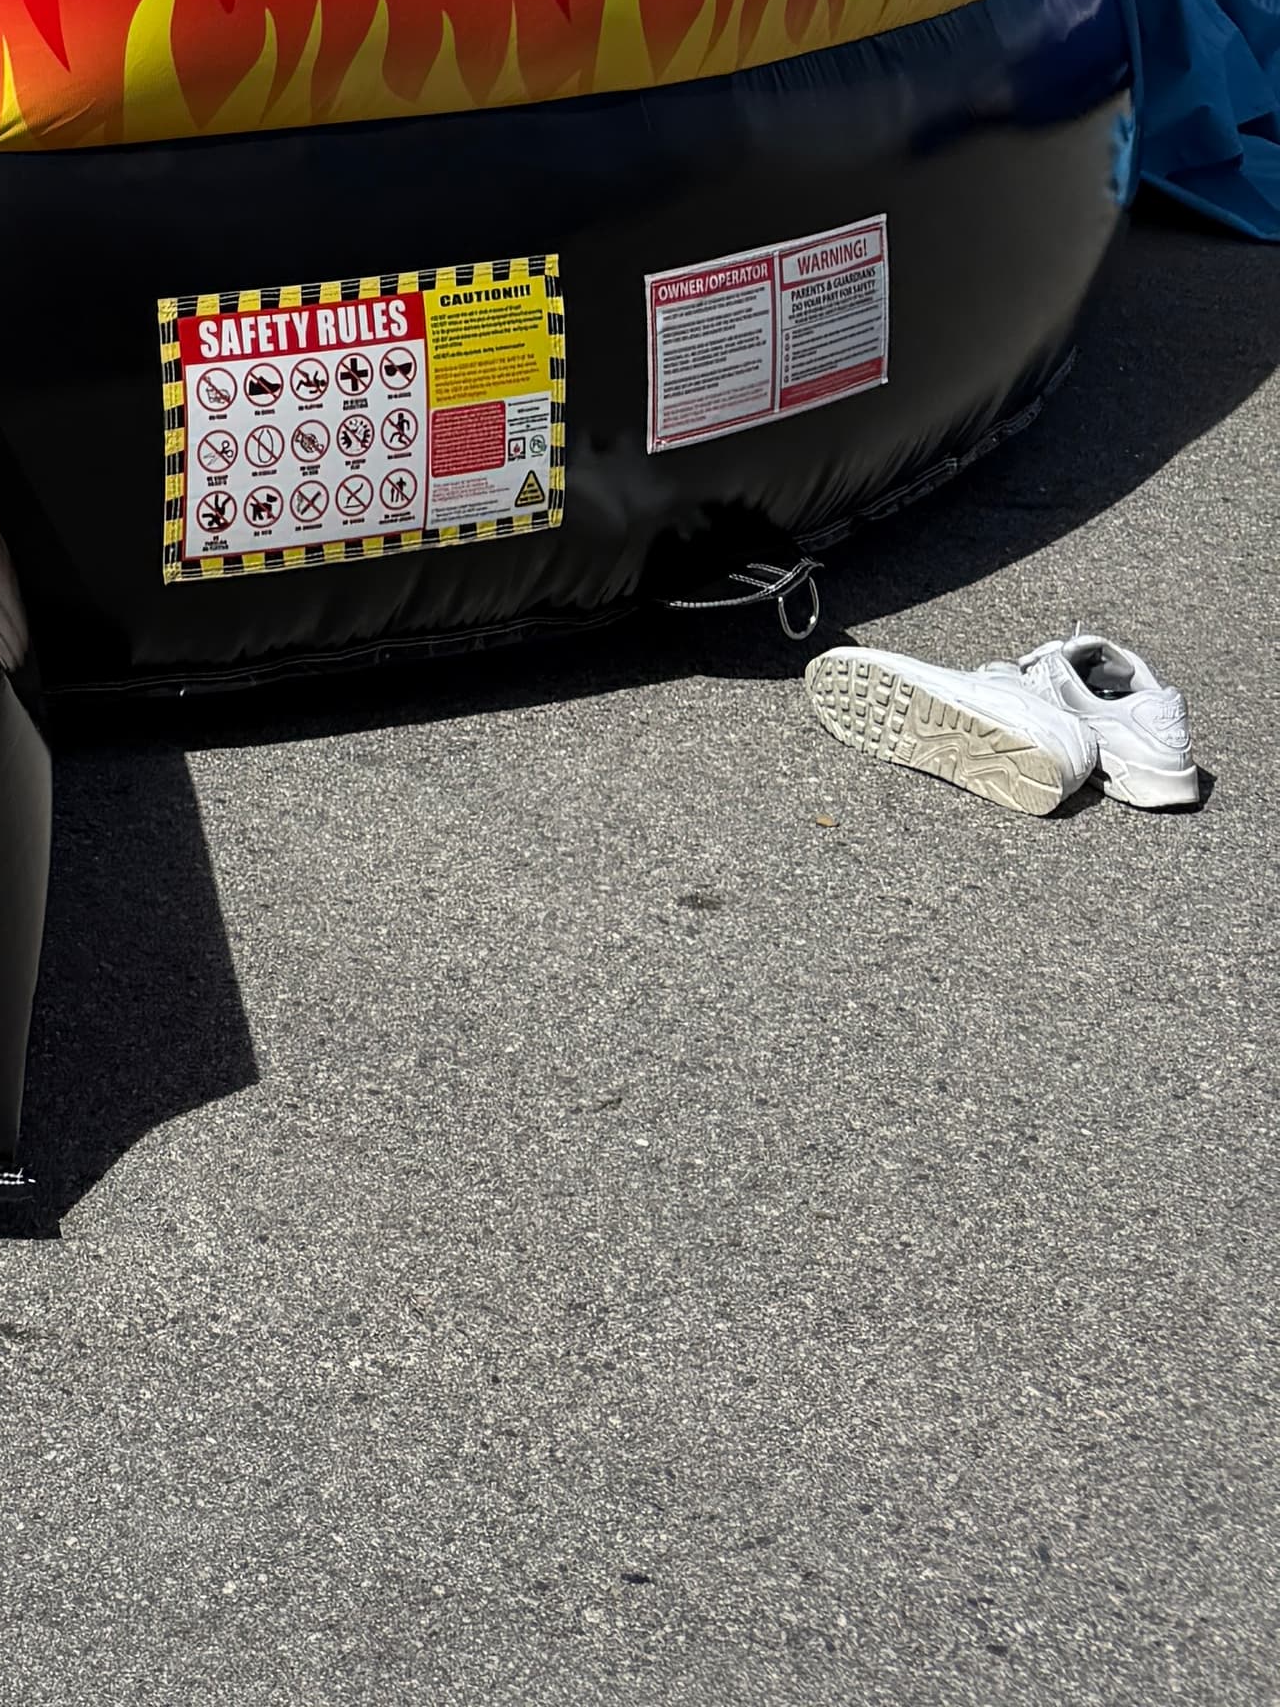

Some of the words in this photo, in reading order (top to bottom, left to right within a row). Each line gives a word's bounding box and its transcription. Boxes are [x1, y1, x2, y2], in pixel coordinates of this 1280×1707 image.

[797, 237, 867, 276] WARNING!
[439, 284, 531, 308] CAUTION!!!
[658, 263, 768, 301] OWNER/OPERATOR
[198, 311, 309, 359] SAFETY
[315, 299, 408, 347] RULES
